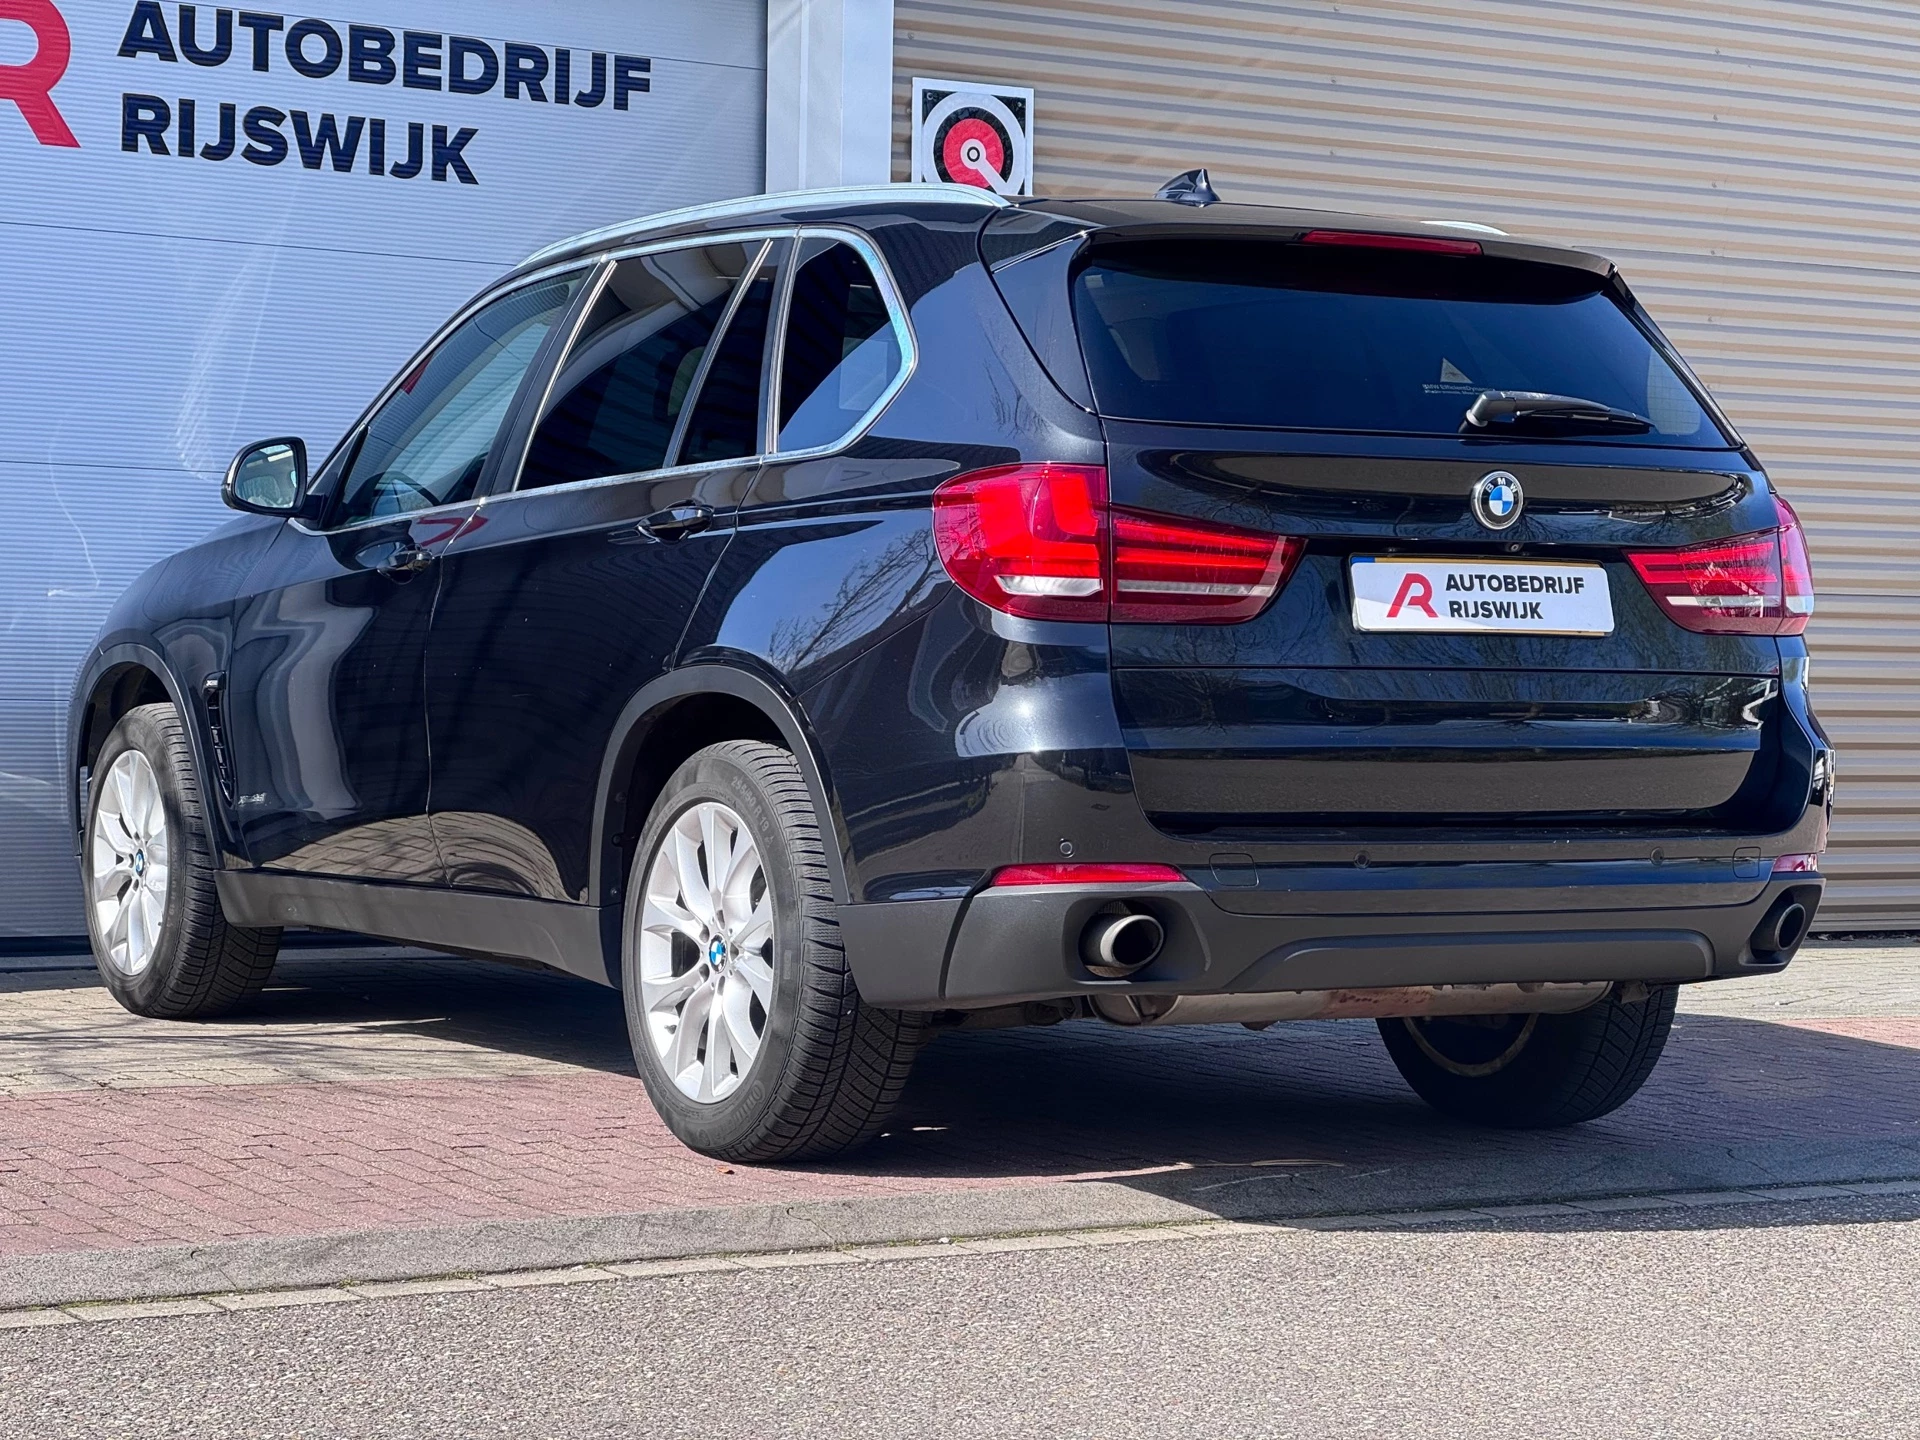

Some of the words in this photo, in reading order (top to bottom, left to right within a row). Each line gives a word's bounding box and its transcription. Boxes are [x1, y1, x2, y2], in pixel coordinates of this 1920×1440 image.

[118, 0, 652, 111] AUTOBEDRIJF
[121, 92, 480, 185] RIJSWIJK
[1485, 477, 1518, 493] BMW
[1446, 573, 1585, 594] AUTOBEDRIJF
[1449, 600, 1543, 619] RIJSWIJK
